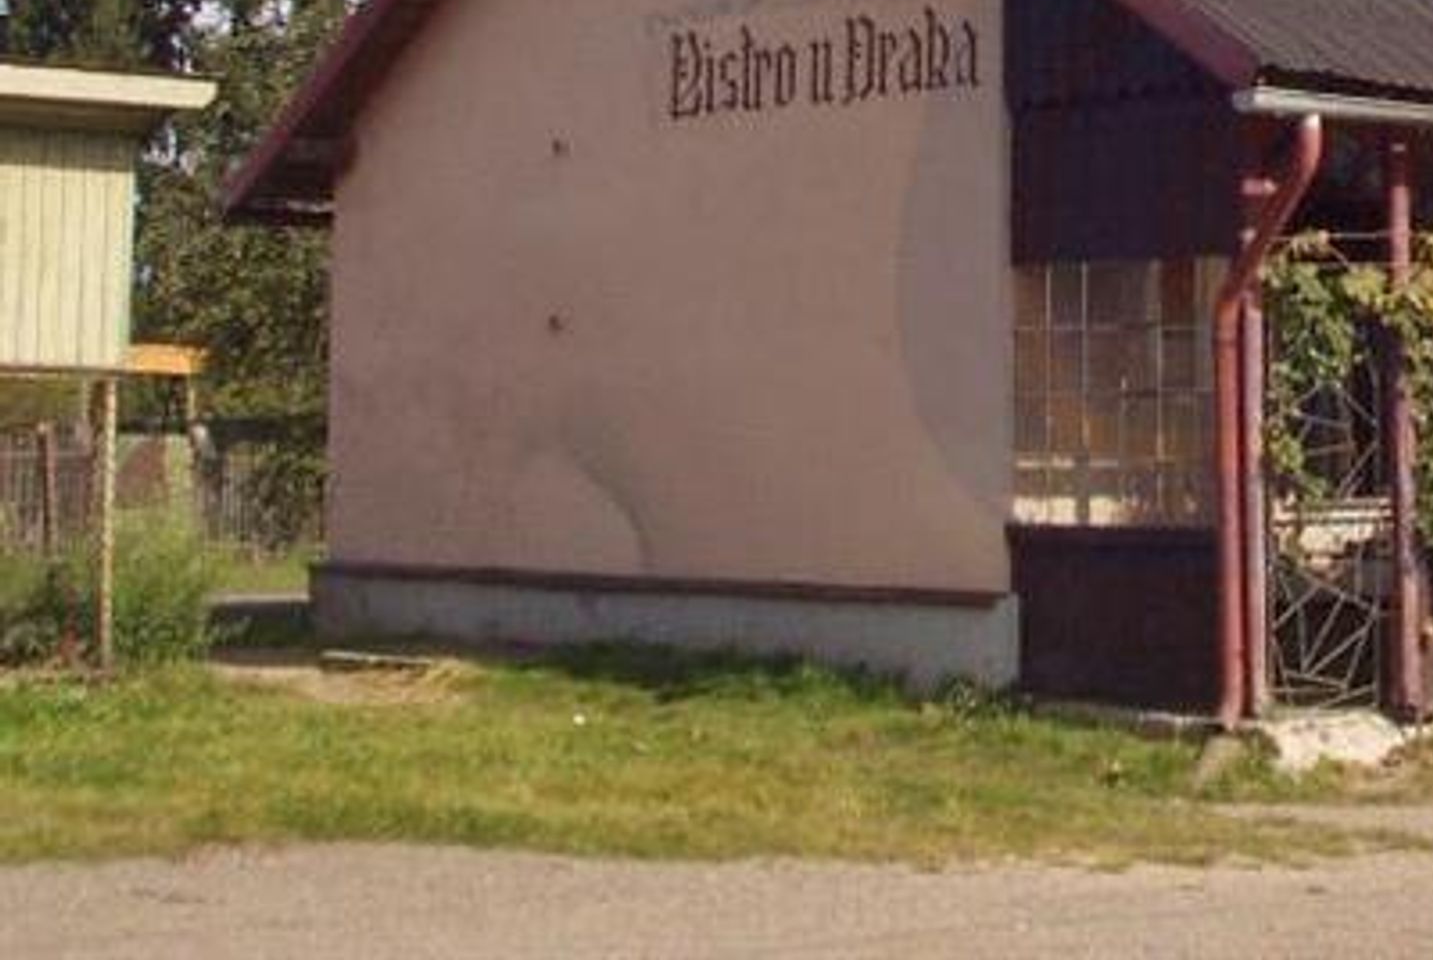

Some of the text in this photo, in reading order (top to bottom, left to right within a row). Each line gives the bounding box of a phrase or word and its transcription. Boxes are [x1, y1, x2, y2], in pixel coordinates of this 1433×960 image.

[669, 5, 980, 121] Bistro u Draka
